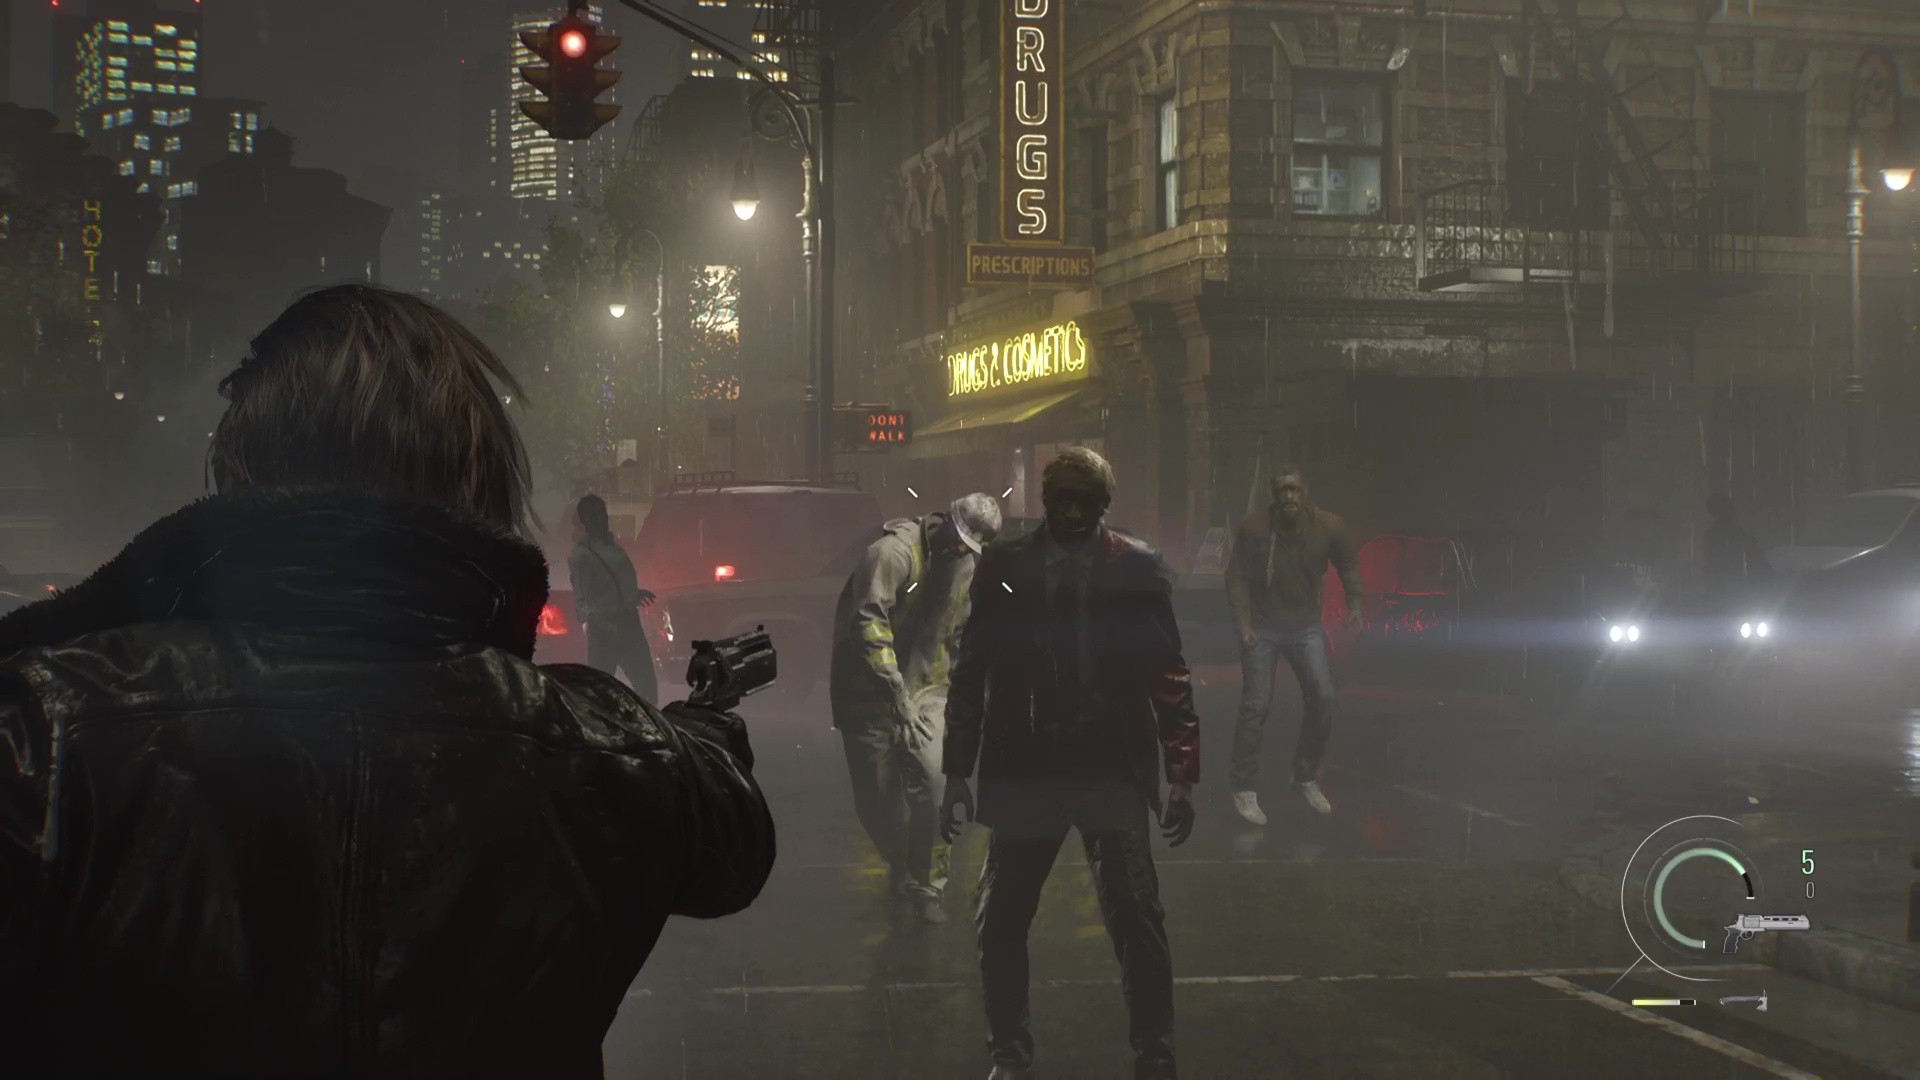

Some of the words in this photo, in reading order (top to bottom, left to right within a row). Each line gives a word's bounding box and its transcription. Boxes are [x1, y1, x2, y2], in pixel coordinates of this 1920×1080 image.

[972, 255, 1090, 276] PRESCRIPTIONS
[947, 346, 989, 396] DRUGS
[1003, 320, 1086, 385] COSMETICS
